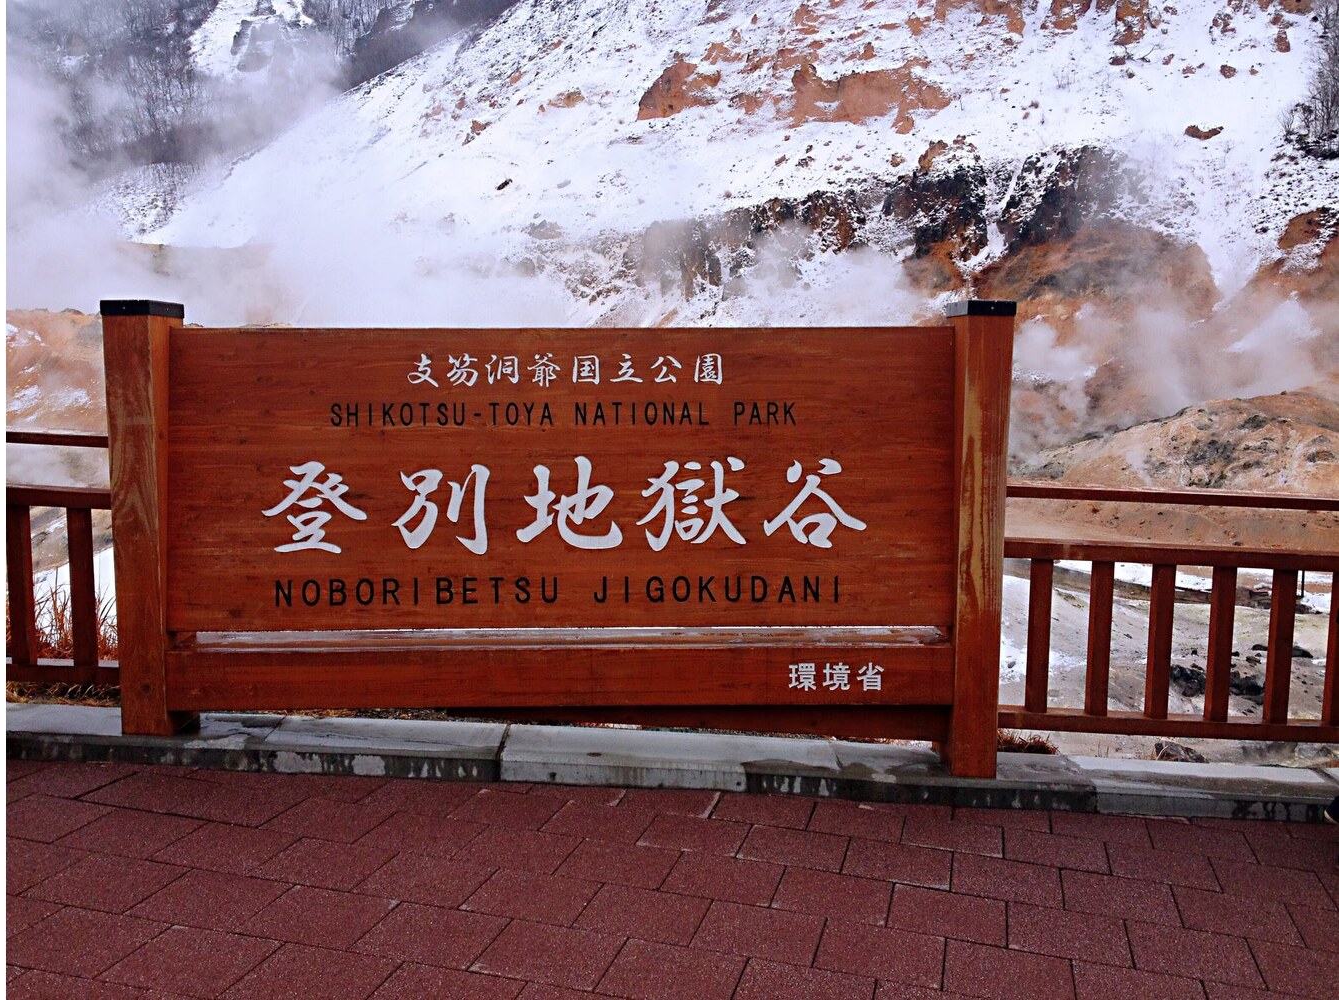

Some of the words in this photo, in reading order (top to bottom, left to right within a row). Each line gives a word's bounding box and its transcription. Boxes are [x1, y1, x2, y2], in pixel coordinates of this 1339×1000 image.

[407, 352, 724, 388] 支笏洞爺国立公園
[330, 402, 554, 427] SHIKOTSU-TOYA
[574, 401, 710, 426] NATIONAL
[734, 401, 797, 425] PARK
[261, 456, 867, 555] 登別地獄谷
[274, 577, 559, 607] NOBORIBETSU
[594, 574, 841, 604] JIGOKUDANI
[788, 662, 885, 692] 環境省
